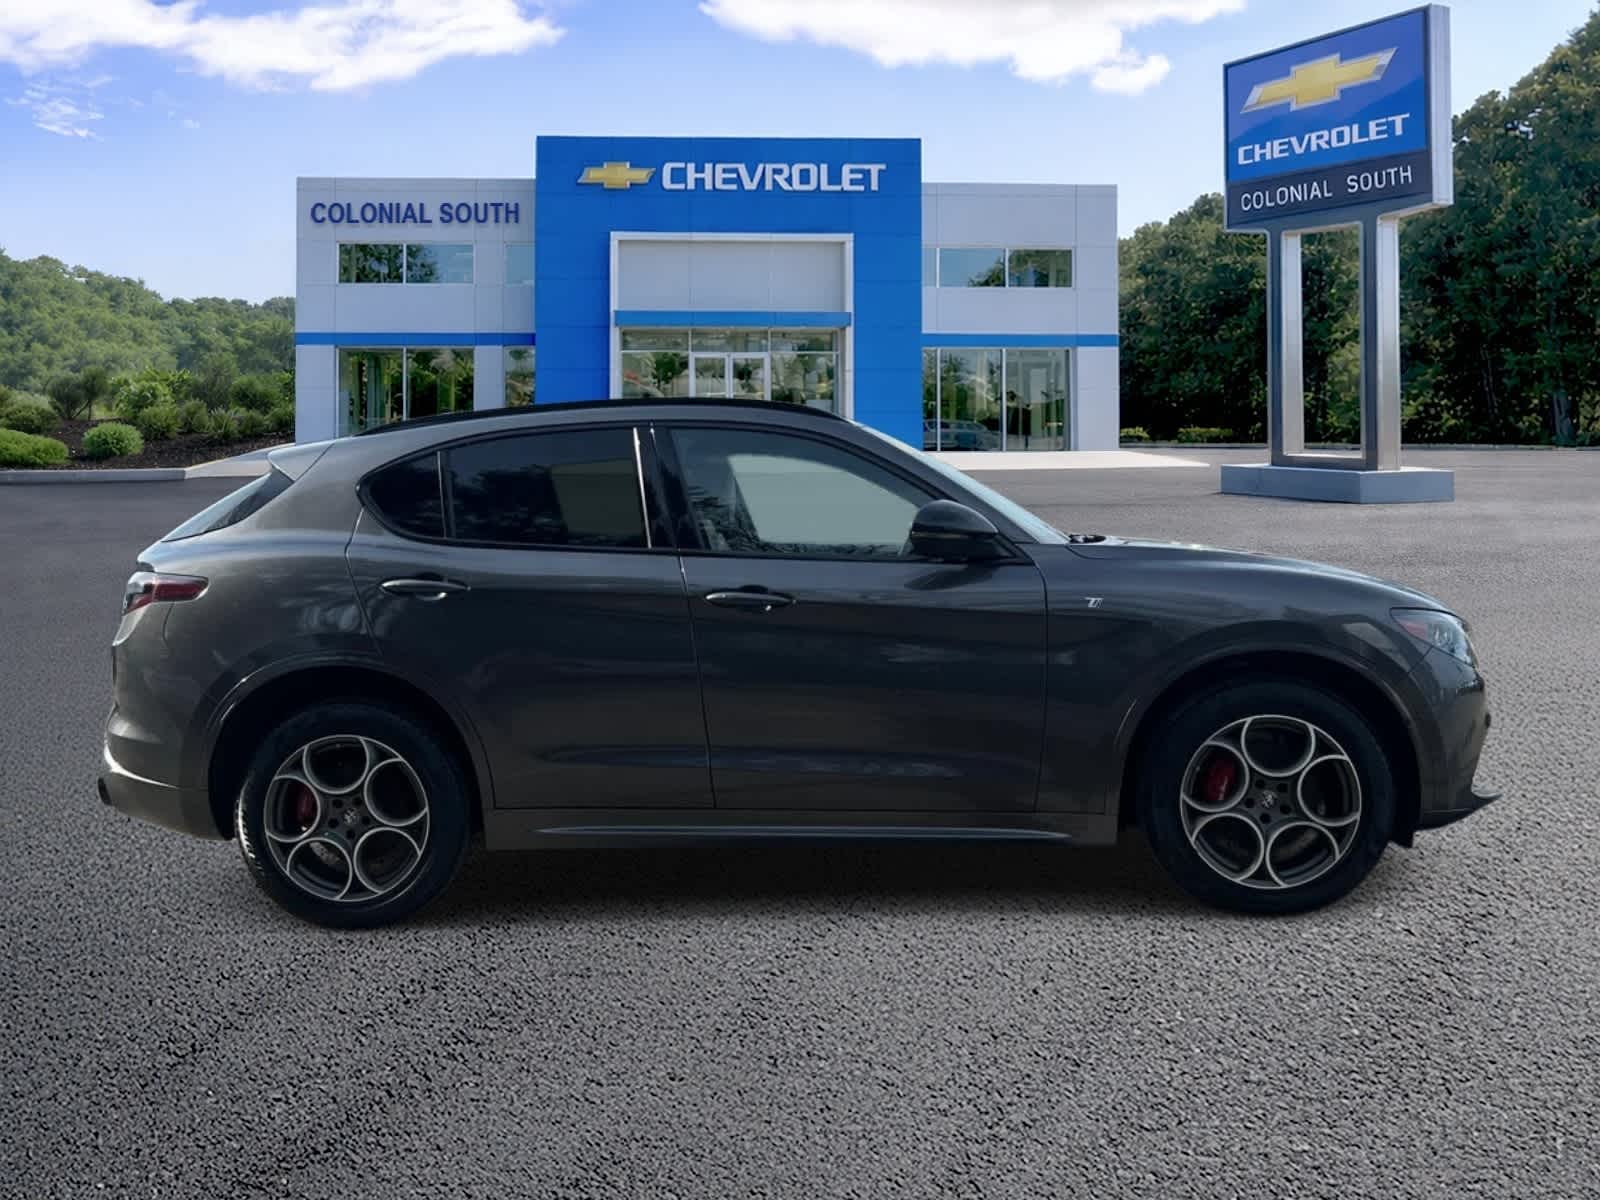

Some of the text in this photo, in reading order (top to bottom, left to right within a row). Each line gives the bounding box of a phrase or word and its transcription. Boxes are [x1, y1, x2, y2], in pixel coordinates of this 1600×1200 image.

[1237, 113, 1410, 165] CHEVROLET
[661, 162, 886, 193] CHEVROLET
[1240, 165, 1413, 211] COLONIAL SOUTH
[310, 202, 521, 224] COLONIAL SOUTH
